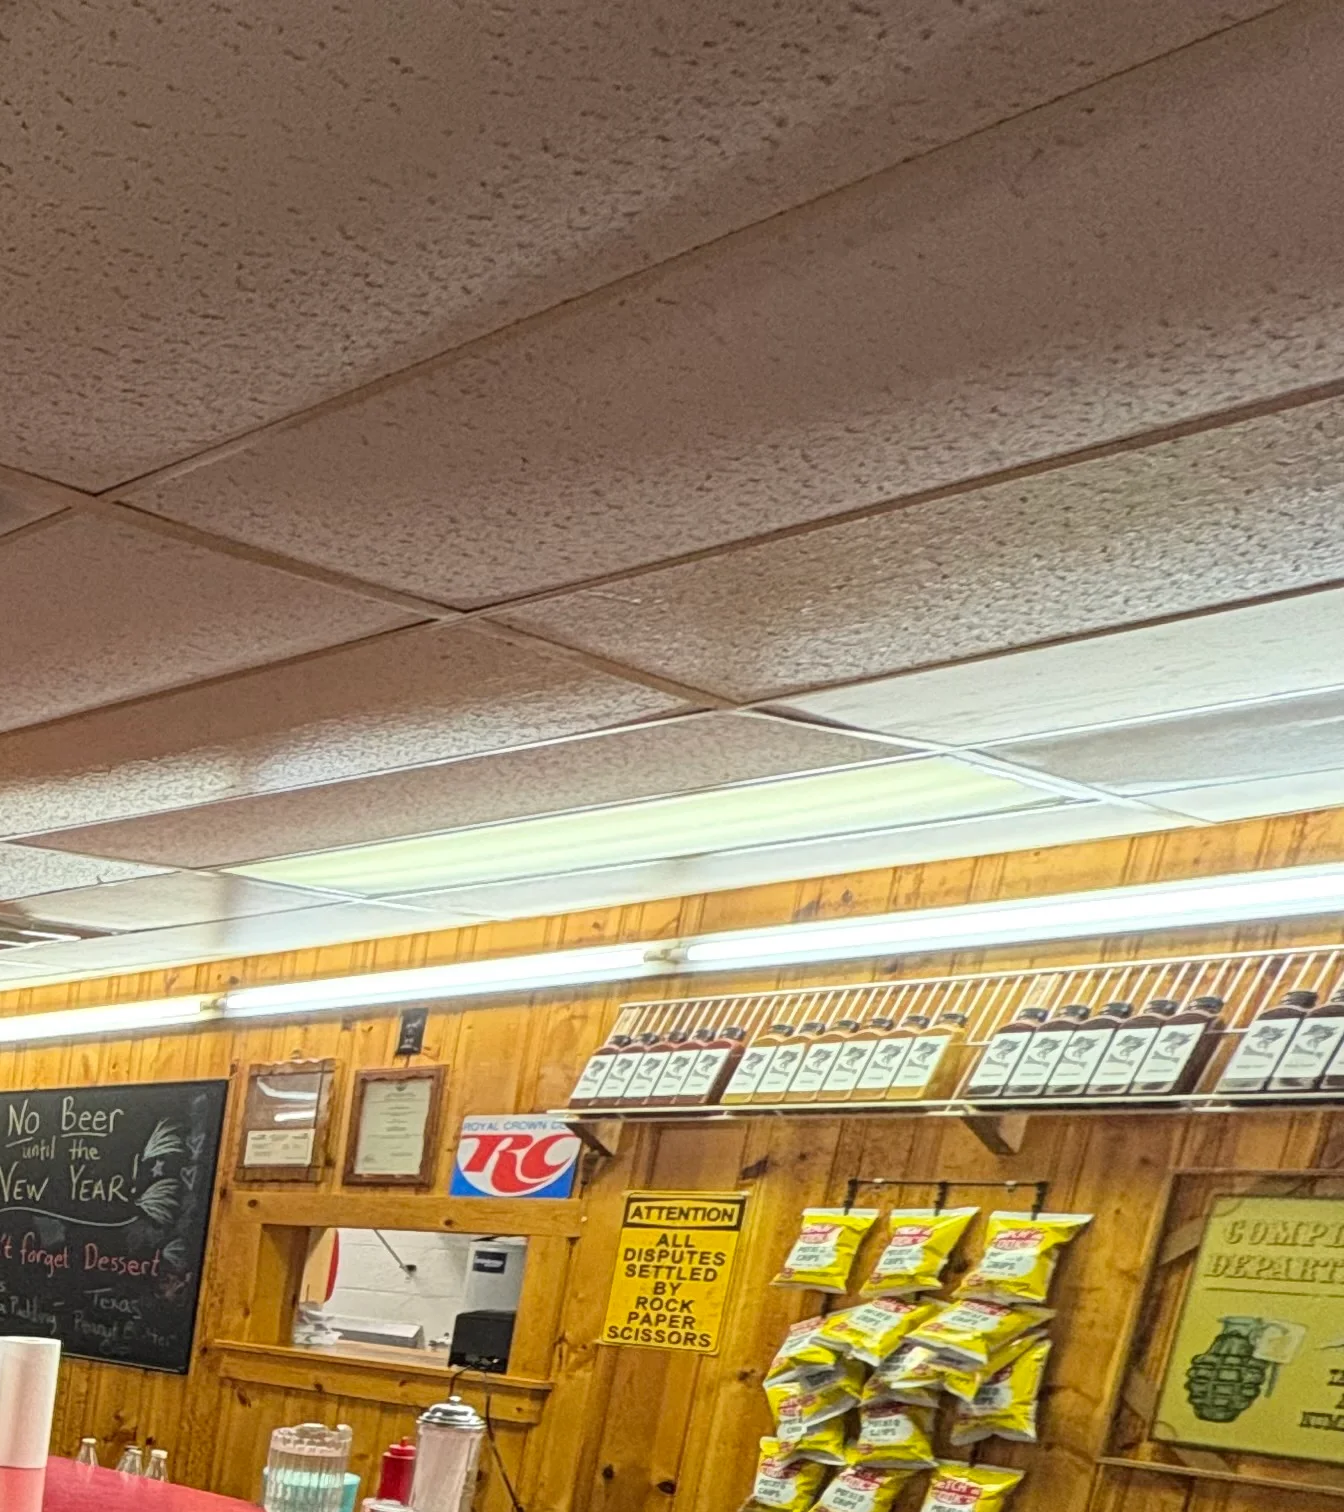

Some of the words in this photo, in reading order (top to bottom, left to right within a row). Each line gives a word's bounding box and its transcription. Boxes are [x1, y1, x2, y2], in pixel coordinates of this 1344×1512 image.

[7, 1098, 40, 1136] No
[61, 1096, 124, 1132] Beer
[463, 1122, 498, 1131] ROYAL
[503, 1120, 548, 1130] CROWN
[21, 1135, 56, 1161] until
[69, 1138, 101, 1161] the
[461, 1133, 577, 1193] RC
[630, 1205, 736, 1222] ATTENTION
[656, 1233, 696, 1248] ALL
[20, 1231, 70, 1278] forget
[84, 1242, 161, 1277] Dessert
[623, 1247, 727, 1266] DISPUTES
[624, 1263, 718, 1282] SETTLED
[1203, 1252, 1344, 1285] DEPART
[653, 1281, 682, 1296] BY
[83, 1287, 143, 1319] Texas
[635, 1296, 696, 1314] ROCK
[627, 1312, 697, 1330] PAPER
[606, 1326, 712, 1348] SCISSORS
